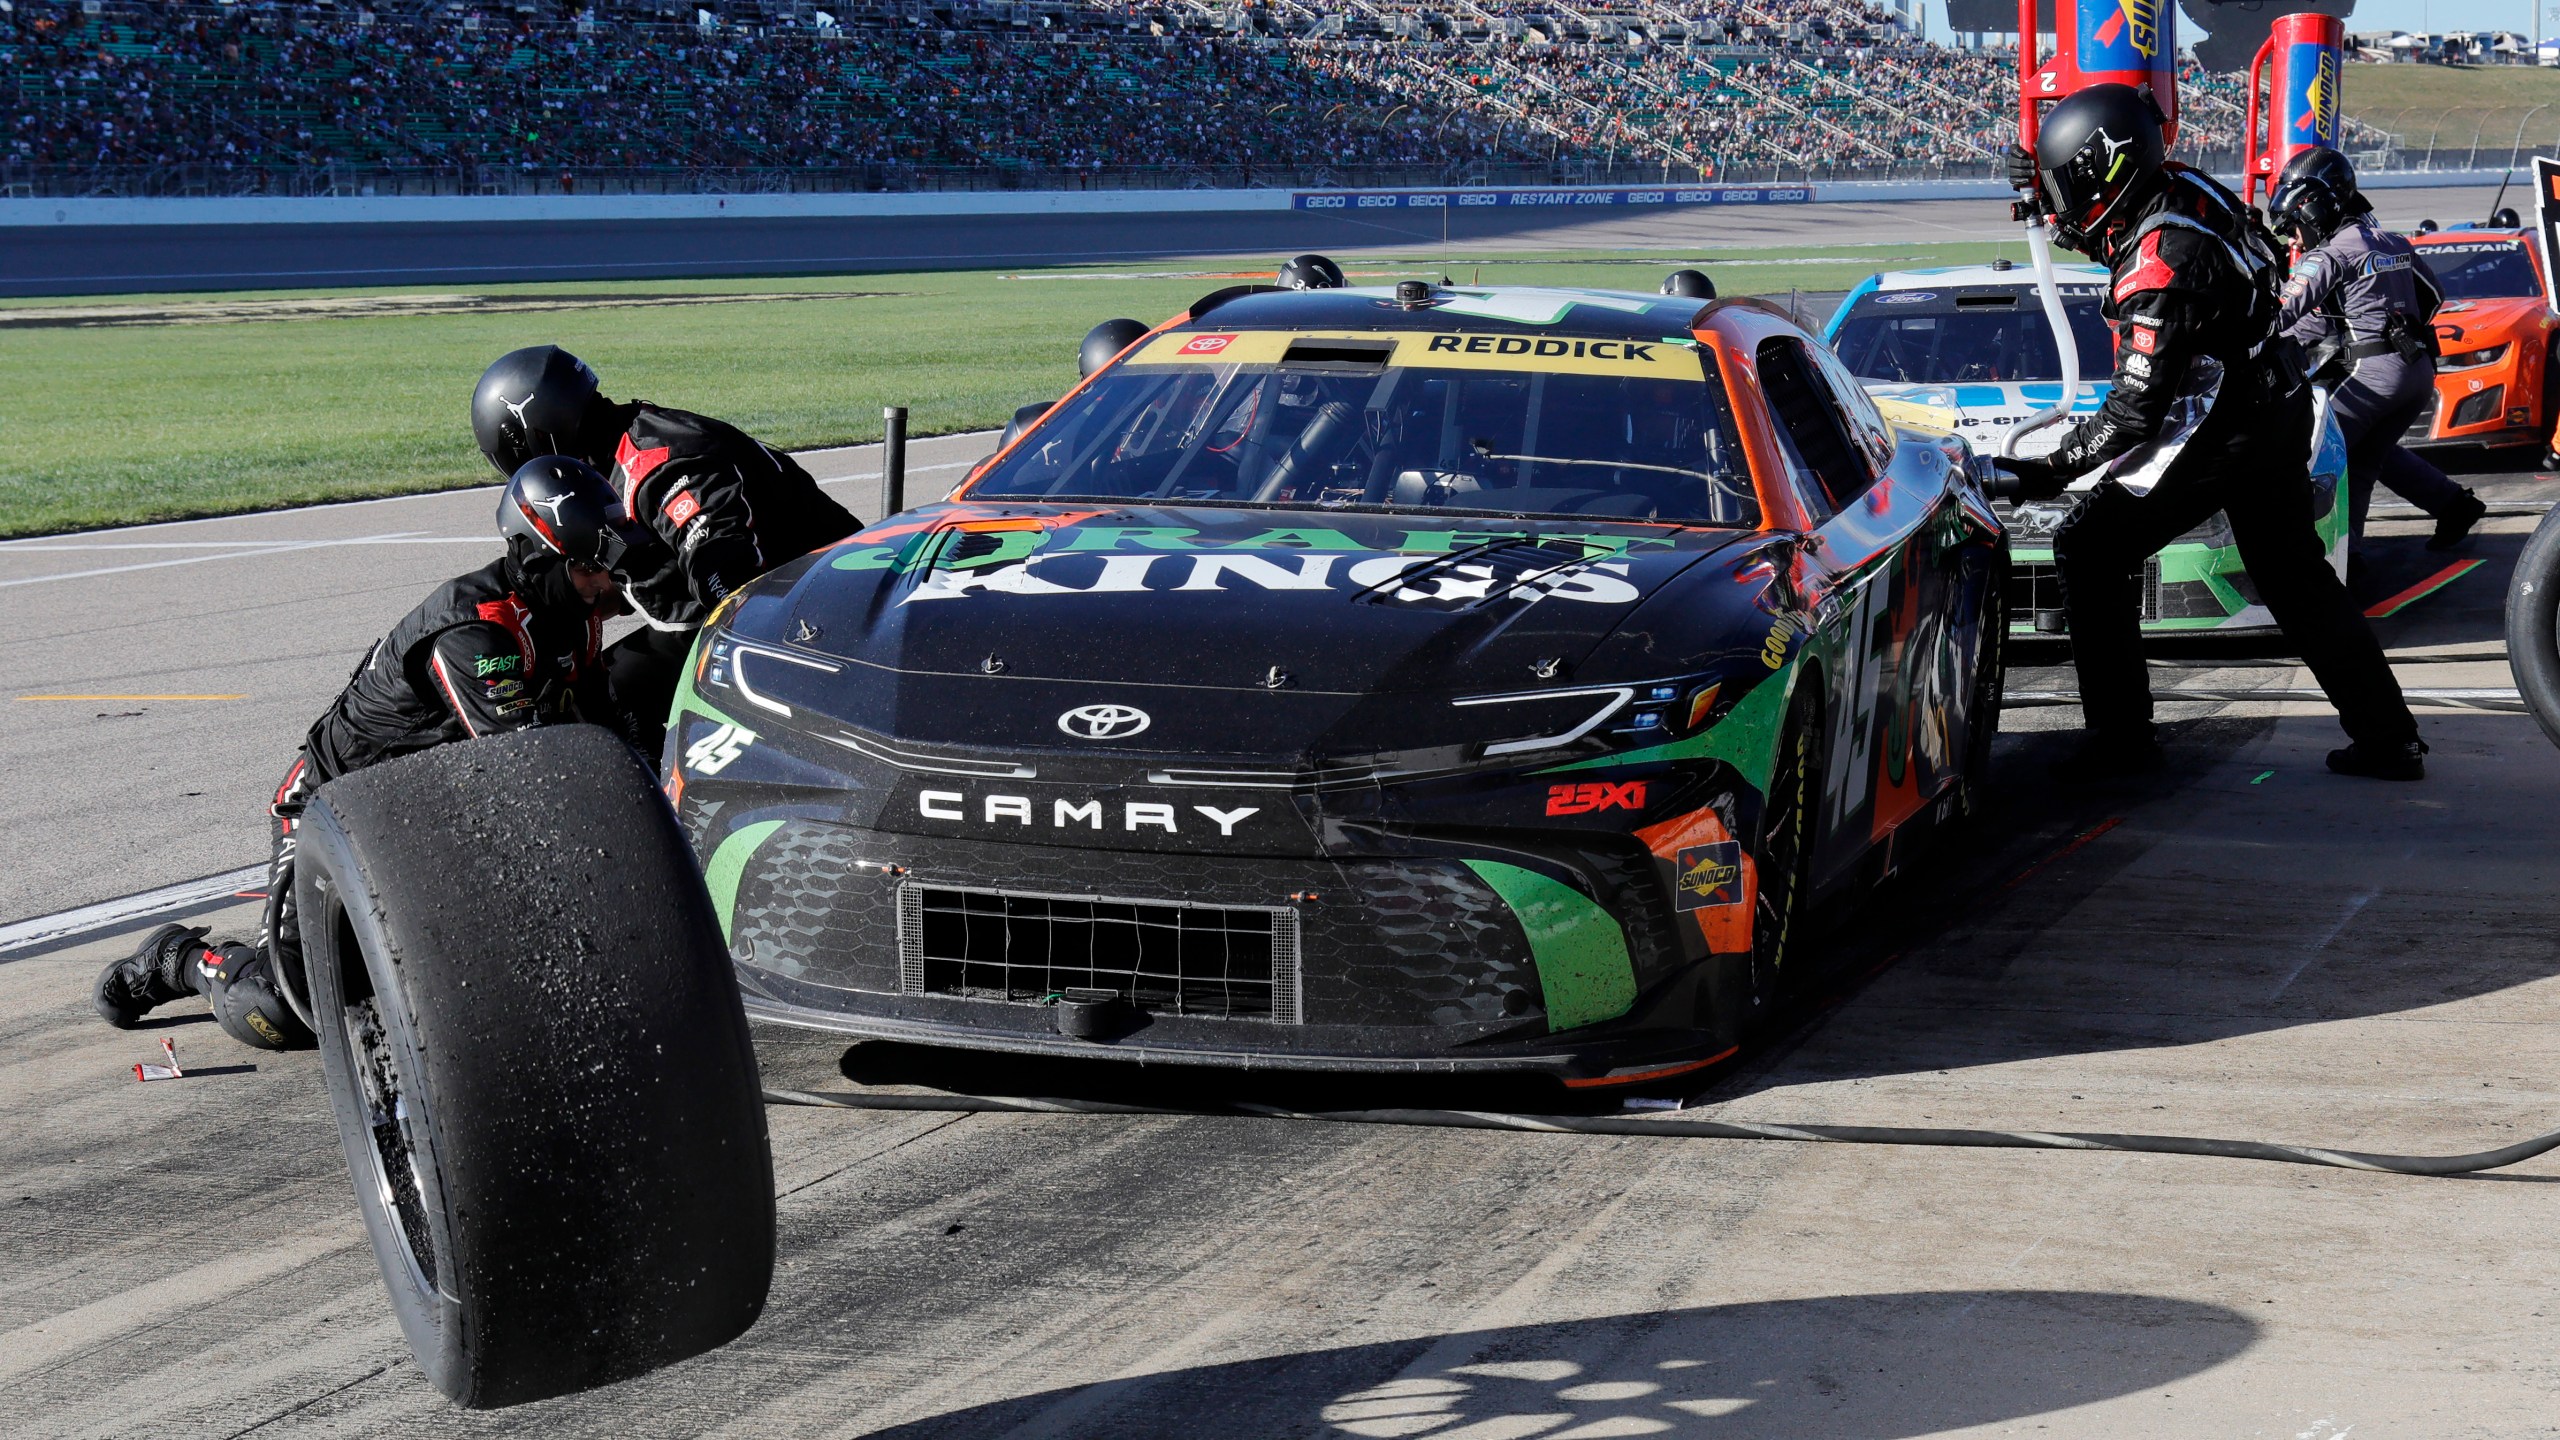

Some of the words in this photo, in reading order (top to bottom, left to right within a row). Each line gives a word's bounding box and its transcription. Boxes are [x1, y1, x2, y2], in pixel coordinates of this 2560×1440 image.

[2040, 72, 2057, 92] 2
[2317, 55, 2335, 138] SUNOCO
[2260, 157, 2272, 171] 3
[1306, 196, 1346, 208] GEICO
[1357, 195, 1397, 207] GEICO
[1408, 195, 1447, 206] GEICO
[1458, 194, 1497, 205] GEICO
[1510, 193, 1574, 205] RESTART
[1575, 193, 1614, 204] ZONE
[1627, 192, 1665, 203] GEICO
[1675, 191, 1712, 202] GEICO
[1722, 190, 1758, 201] GEICO
[1768, 190, 1805, 201] GEICO
[2414, 243, 2518, 255] CHASTAIN
[1428, 335, 1657, 362] REDDICK
[2123, 374, 2149, 392] xfinity
[2066, 445, 2085, 464] AIR
[2086, 420, 2118, 457] JORDAN
[684, 526, 710, 552] xfinity
[831, 526, 1676, 573] DRAFT
[896, 552, 1640, 608] KINGS
[474, 655, 521, 678] BEAST
[490, 681, 523, 696] SUNOCO
[685, 723, 756, 776] 45
[919, 789, 1261, 837] CAMRY
[1682, 866, 1735, 888] SUNOCO
